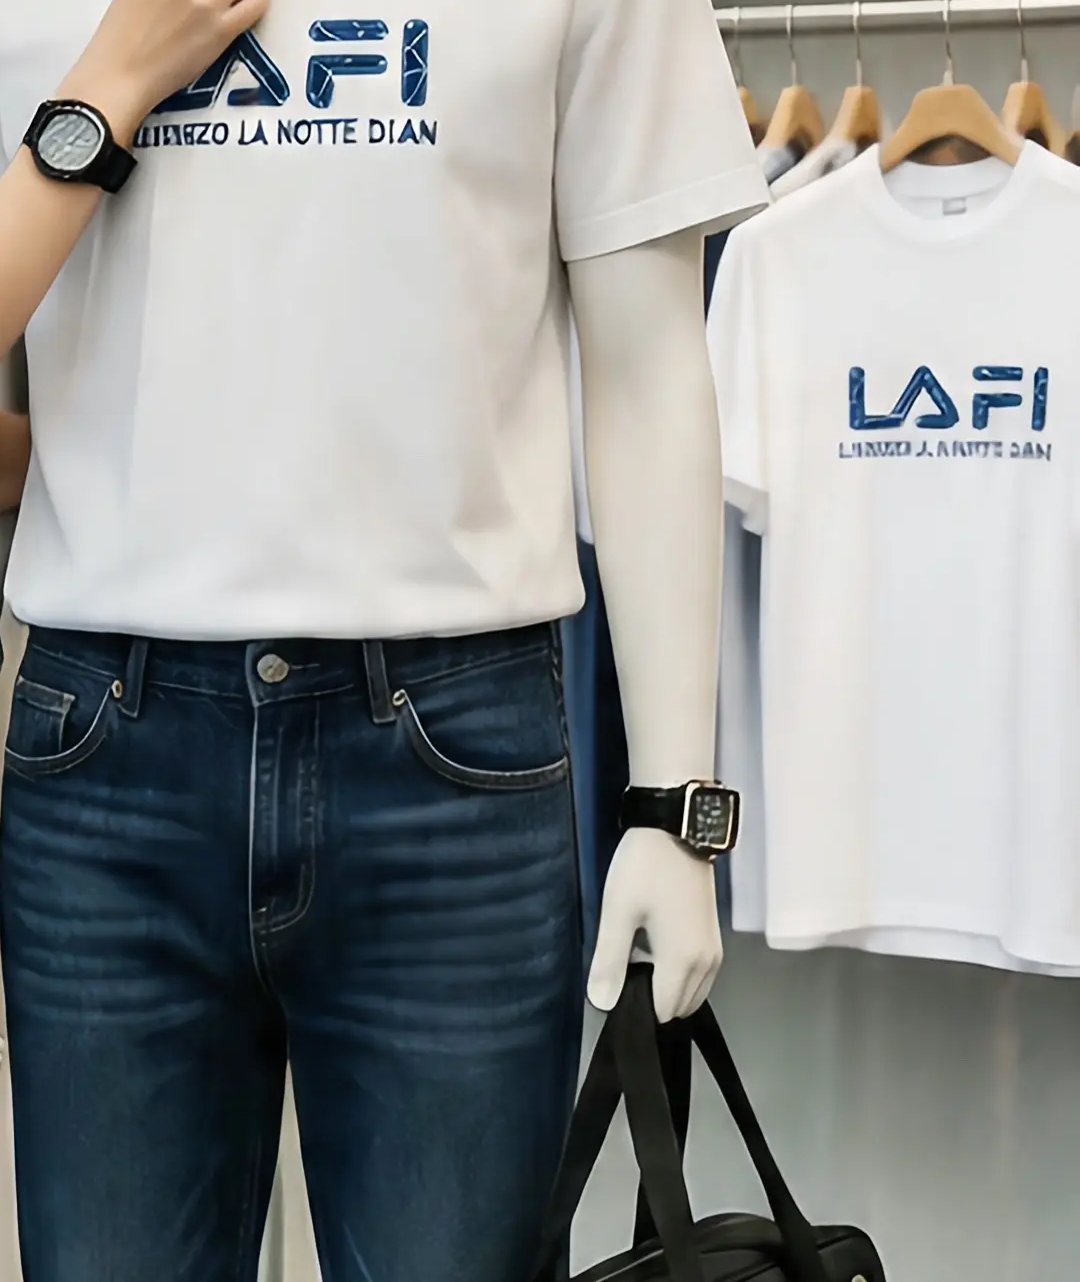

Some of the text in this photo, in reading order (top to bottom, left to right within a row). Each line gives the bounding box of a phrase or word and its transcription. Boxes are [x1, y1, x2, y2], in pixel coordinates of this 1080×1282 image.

[149, 19, 428, 114] AFI
[238, 120, 268, 146] LA
[277, 118, 358, 146] NOTTE
[368, 119, 438, 146] DIAN
[849, 365, 1048, 431] LAFI
